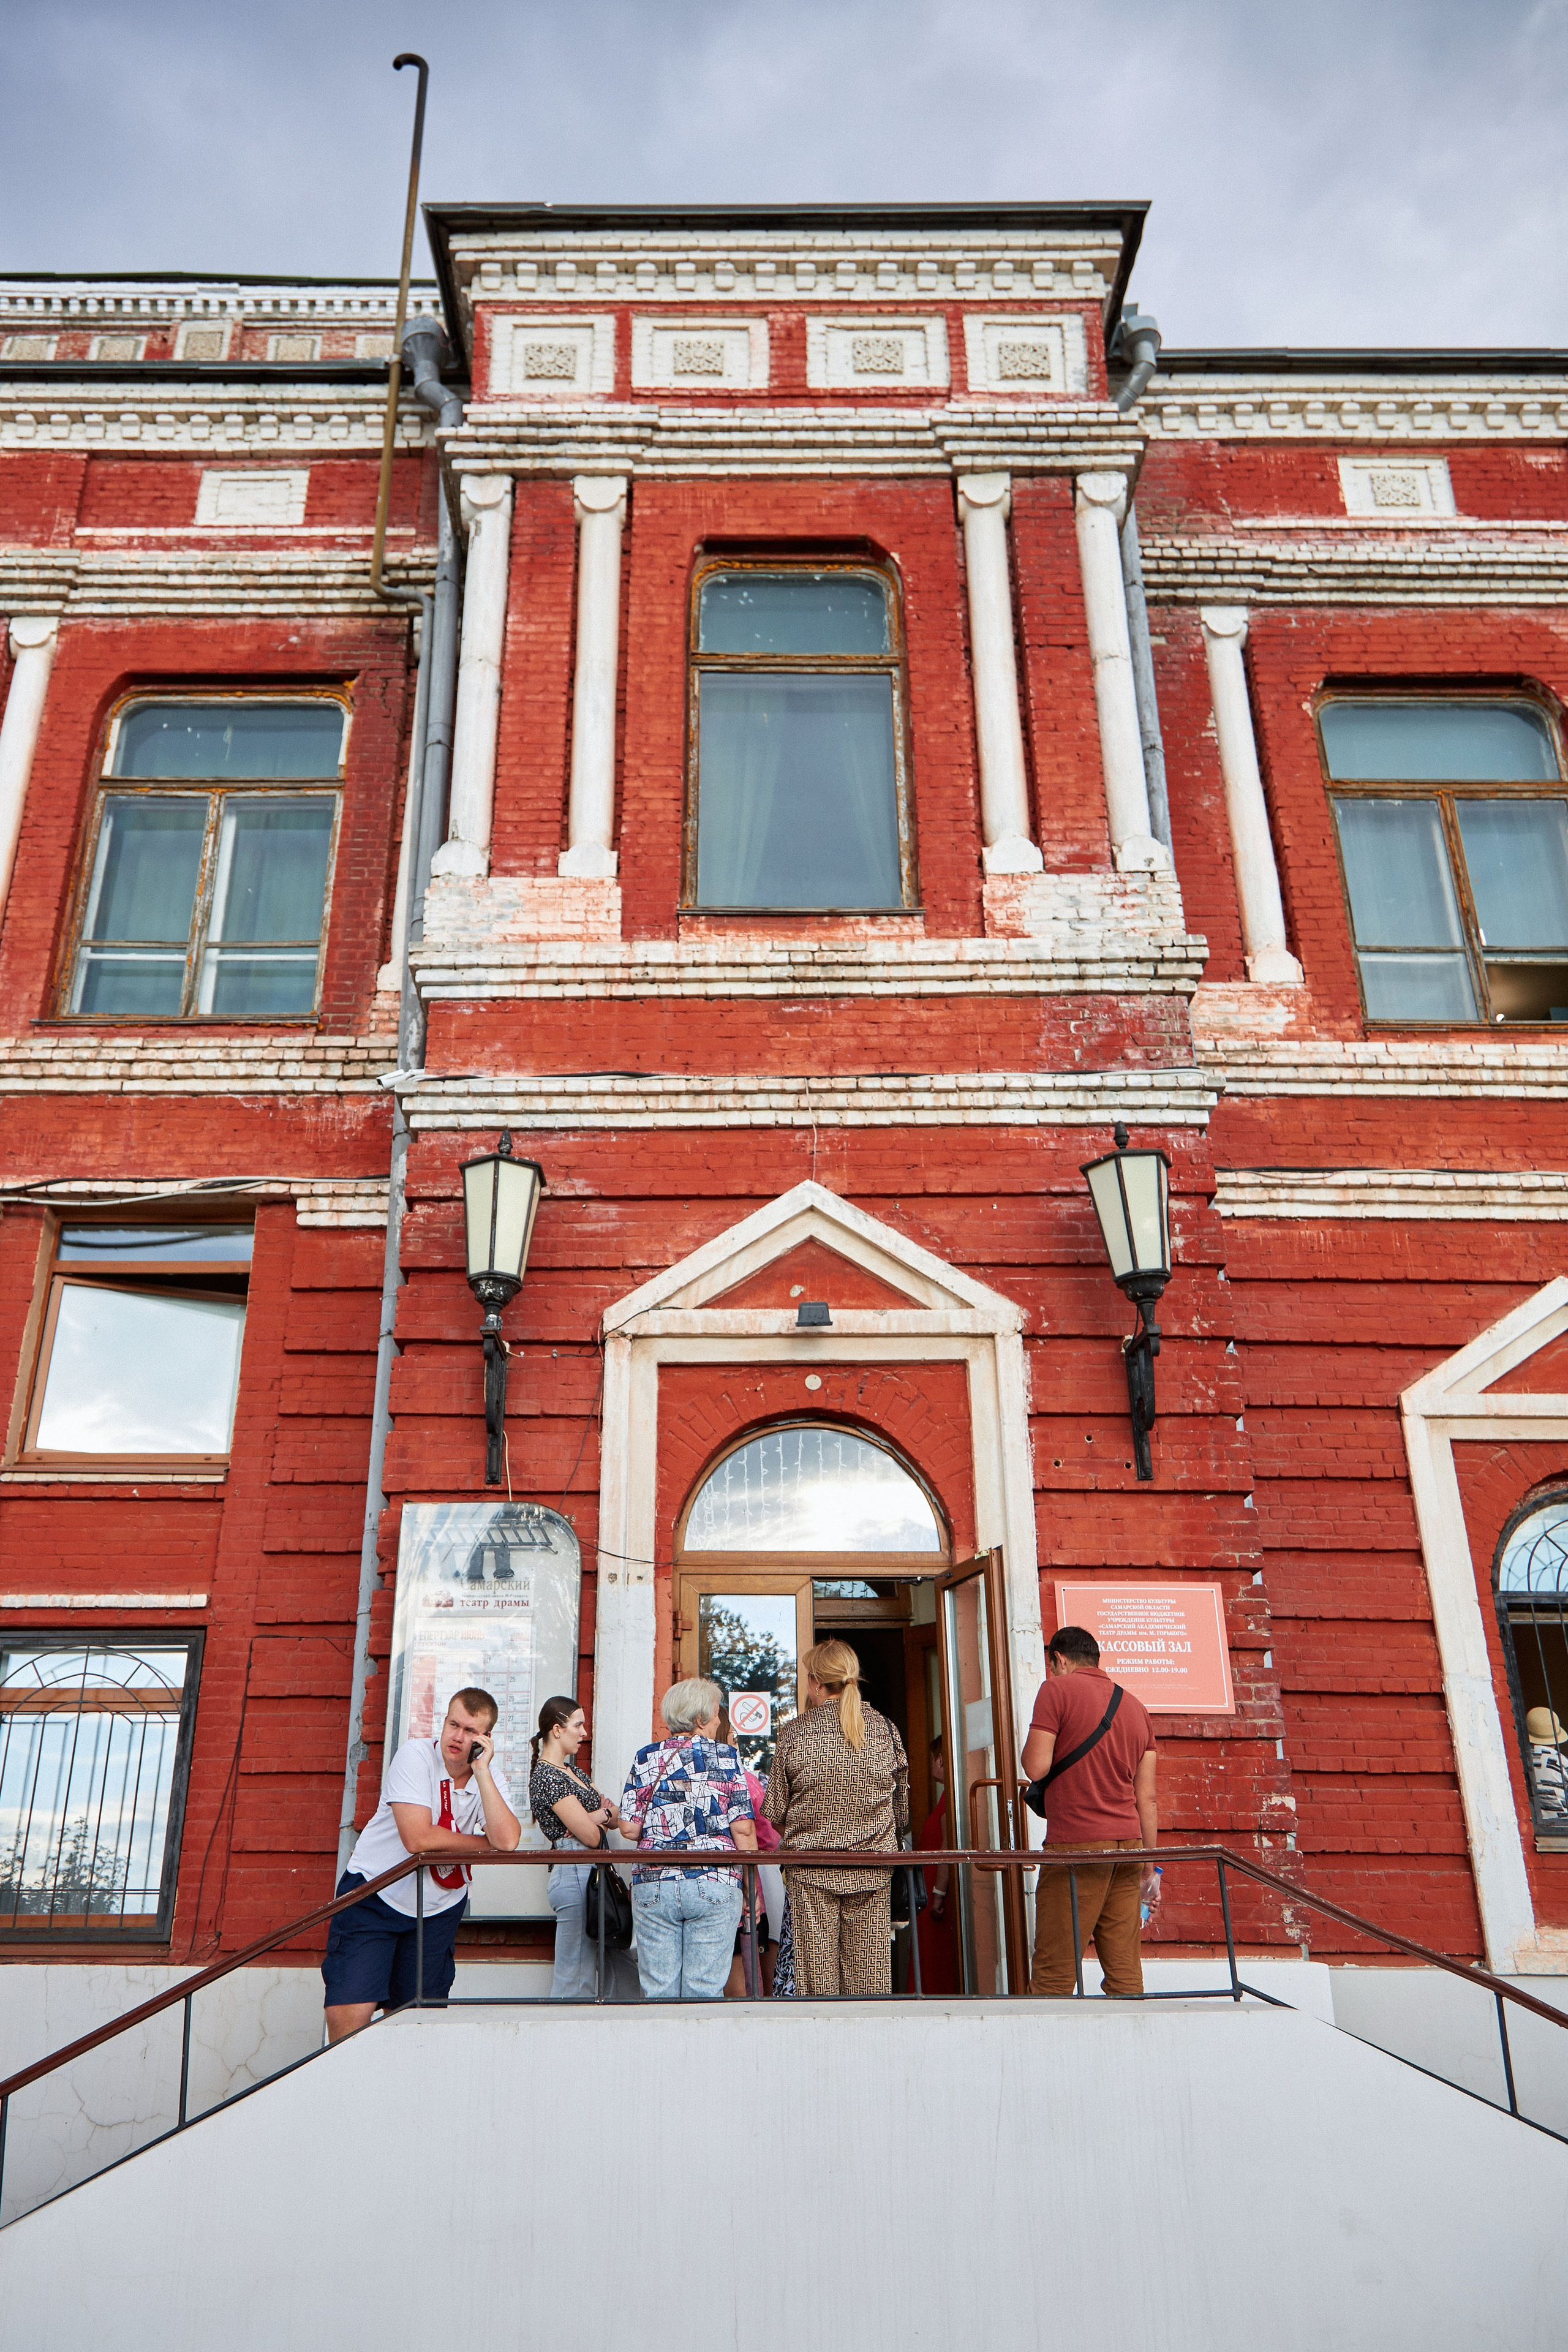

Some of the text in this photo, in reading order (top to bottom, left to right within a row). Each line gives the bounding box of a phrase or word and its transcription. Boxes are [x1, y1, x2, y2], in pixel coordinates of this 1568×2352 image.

[460, 1599, 529, 1609] театр драмы
[1098, 1638, 1192, 1653] КАССОВЫЙ ЗАЛ
